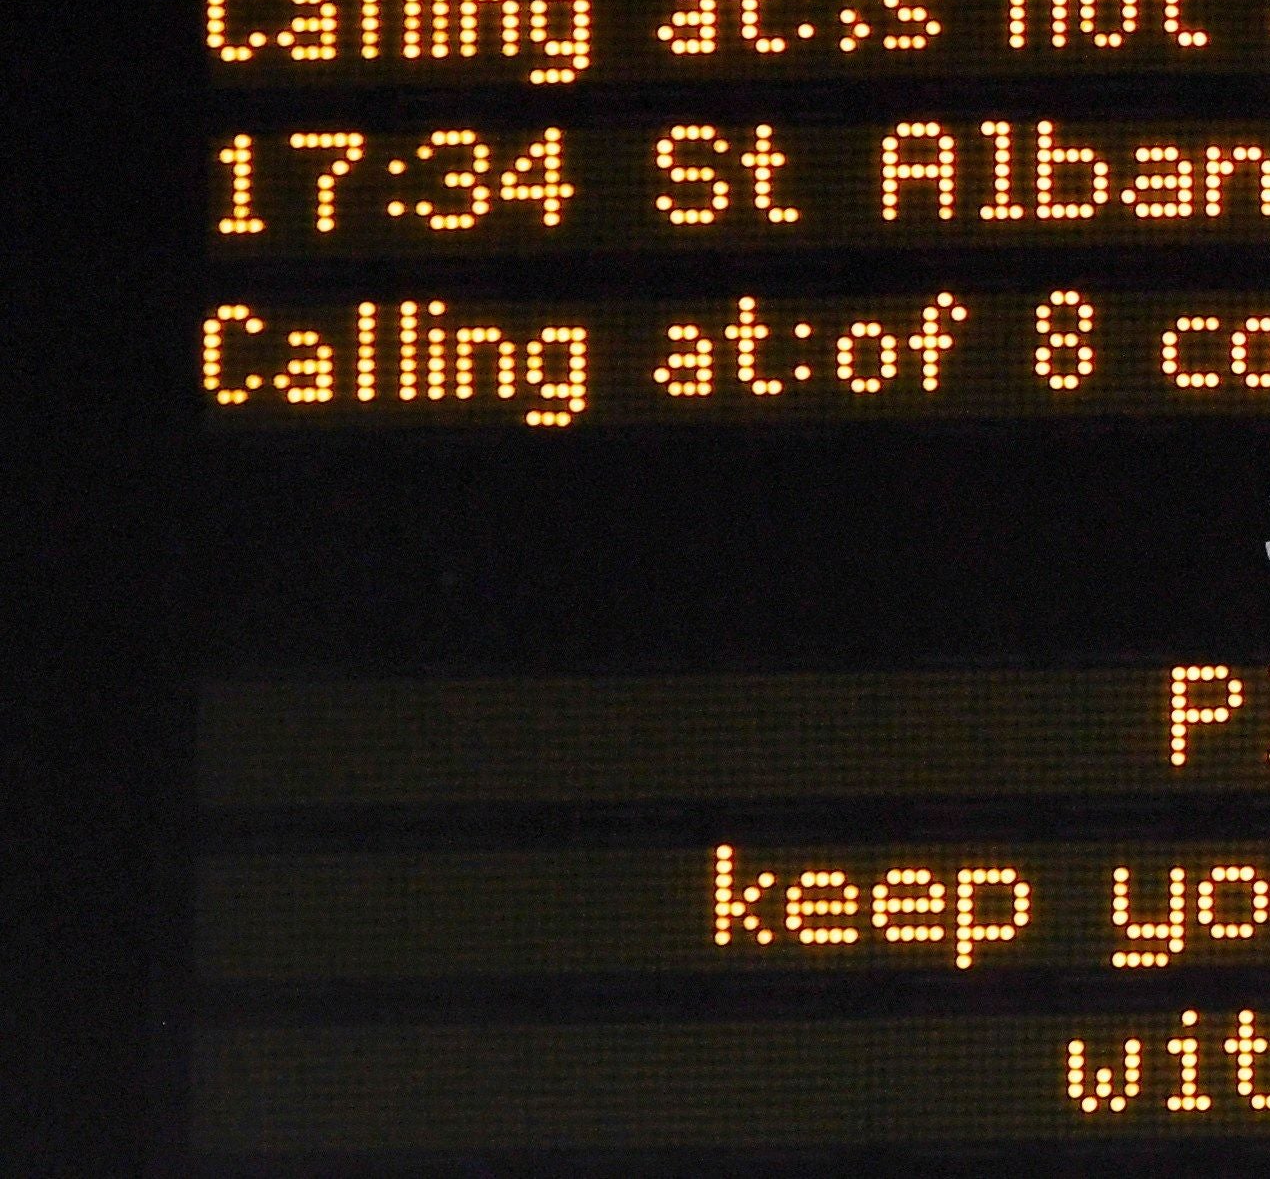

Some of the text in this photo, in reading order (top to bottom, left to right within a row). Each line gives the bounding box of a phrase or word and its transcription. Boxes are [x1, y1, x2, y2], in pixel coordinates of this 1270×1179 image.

[218, 128, 577, 236] 17:34
[656, 124, 801, 227] St
[202, 300, 589, 429] Calling
[1035, 290, 1096, 392] 8
[714, 844, 1032, 971] keep
